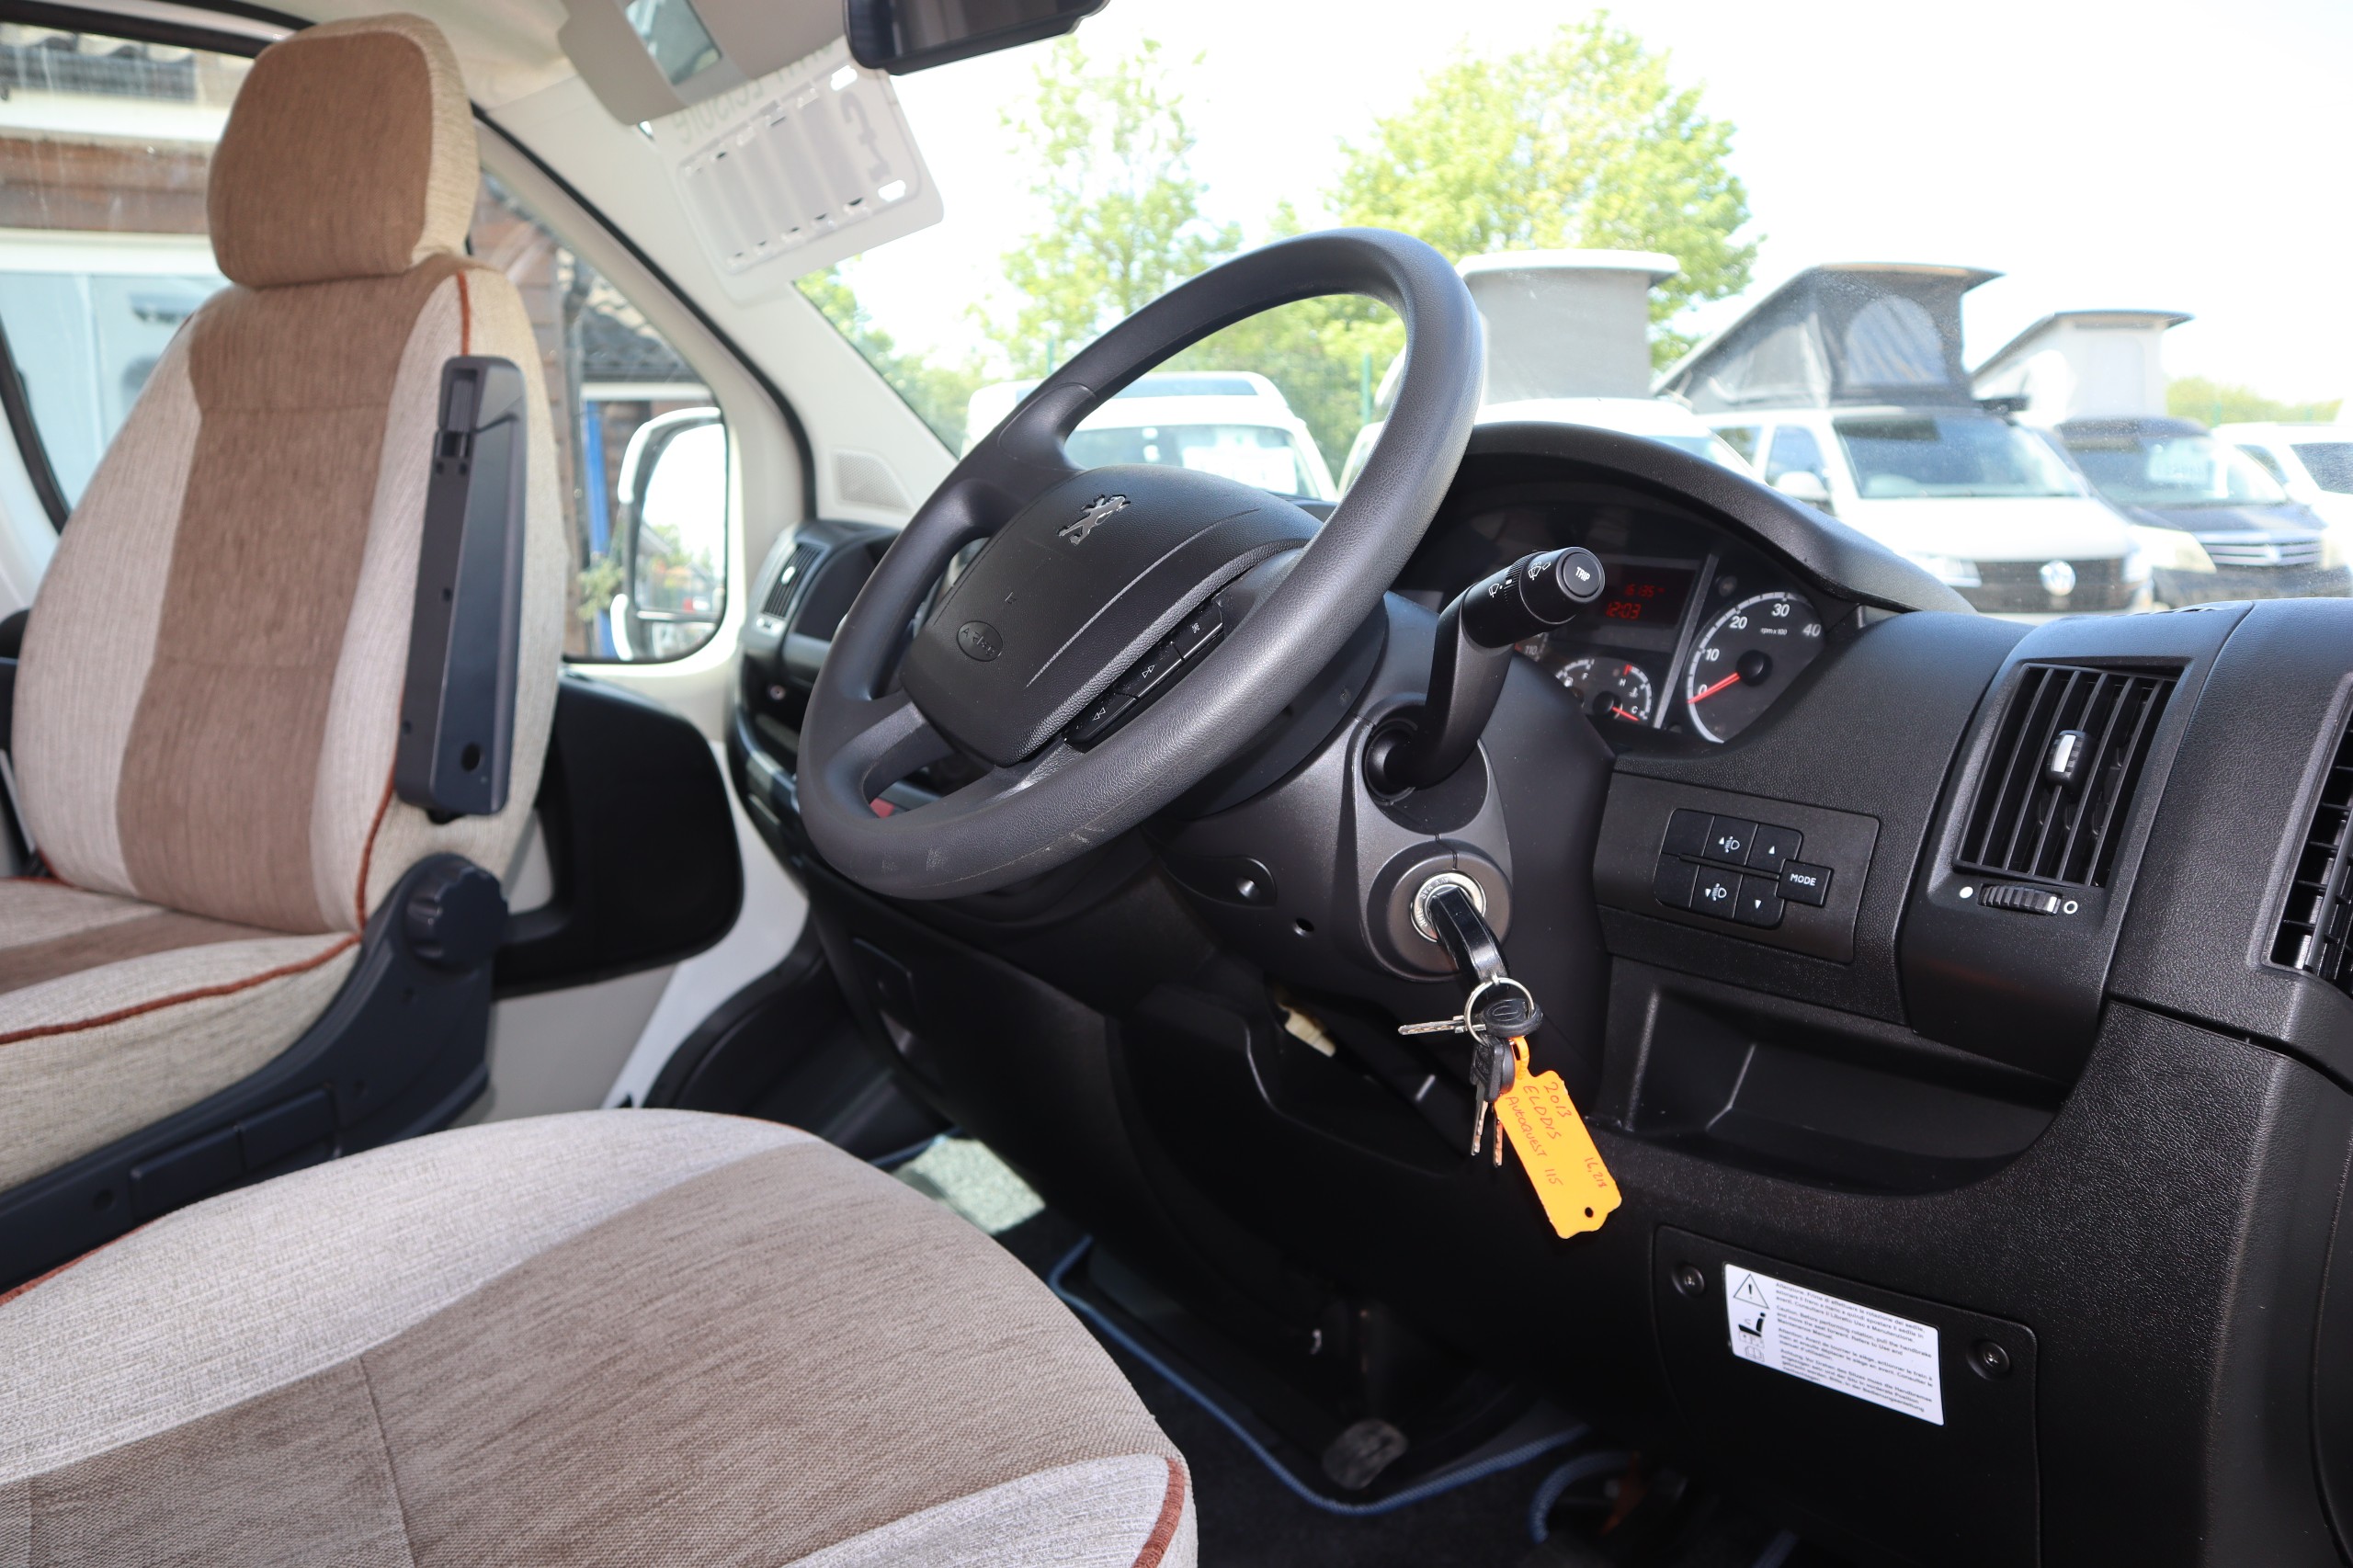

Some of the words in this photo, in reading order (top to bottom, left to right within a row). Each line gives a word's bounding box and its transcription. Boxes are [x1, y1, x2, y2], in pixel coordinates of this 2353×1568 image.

[1575, 566, 1591, 582] TRIP
[1771, 603, 1790, 618] 30
[1729, 616, 1748, 630] 20
[1802, 623, 1822, 637] 40
[1705, 648, 1721, 662] 10
[1581, 672, 1589, 680] F
[1619, 677, 1627, 687] H
[1631, 706, 1639, 714] C
[1790, 873, 1817, 886] MODE
[1544, 1081, 1573, 1118] 2013
[1523, 1085, 1563, 1140] ELDDIS
[1544, 1168, 1563, 1186] 115
